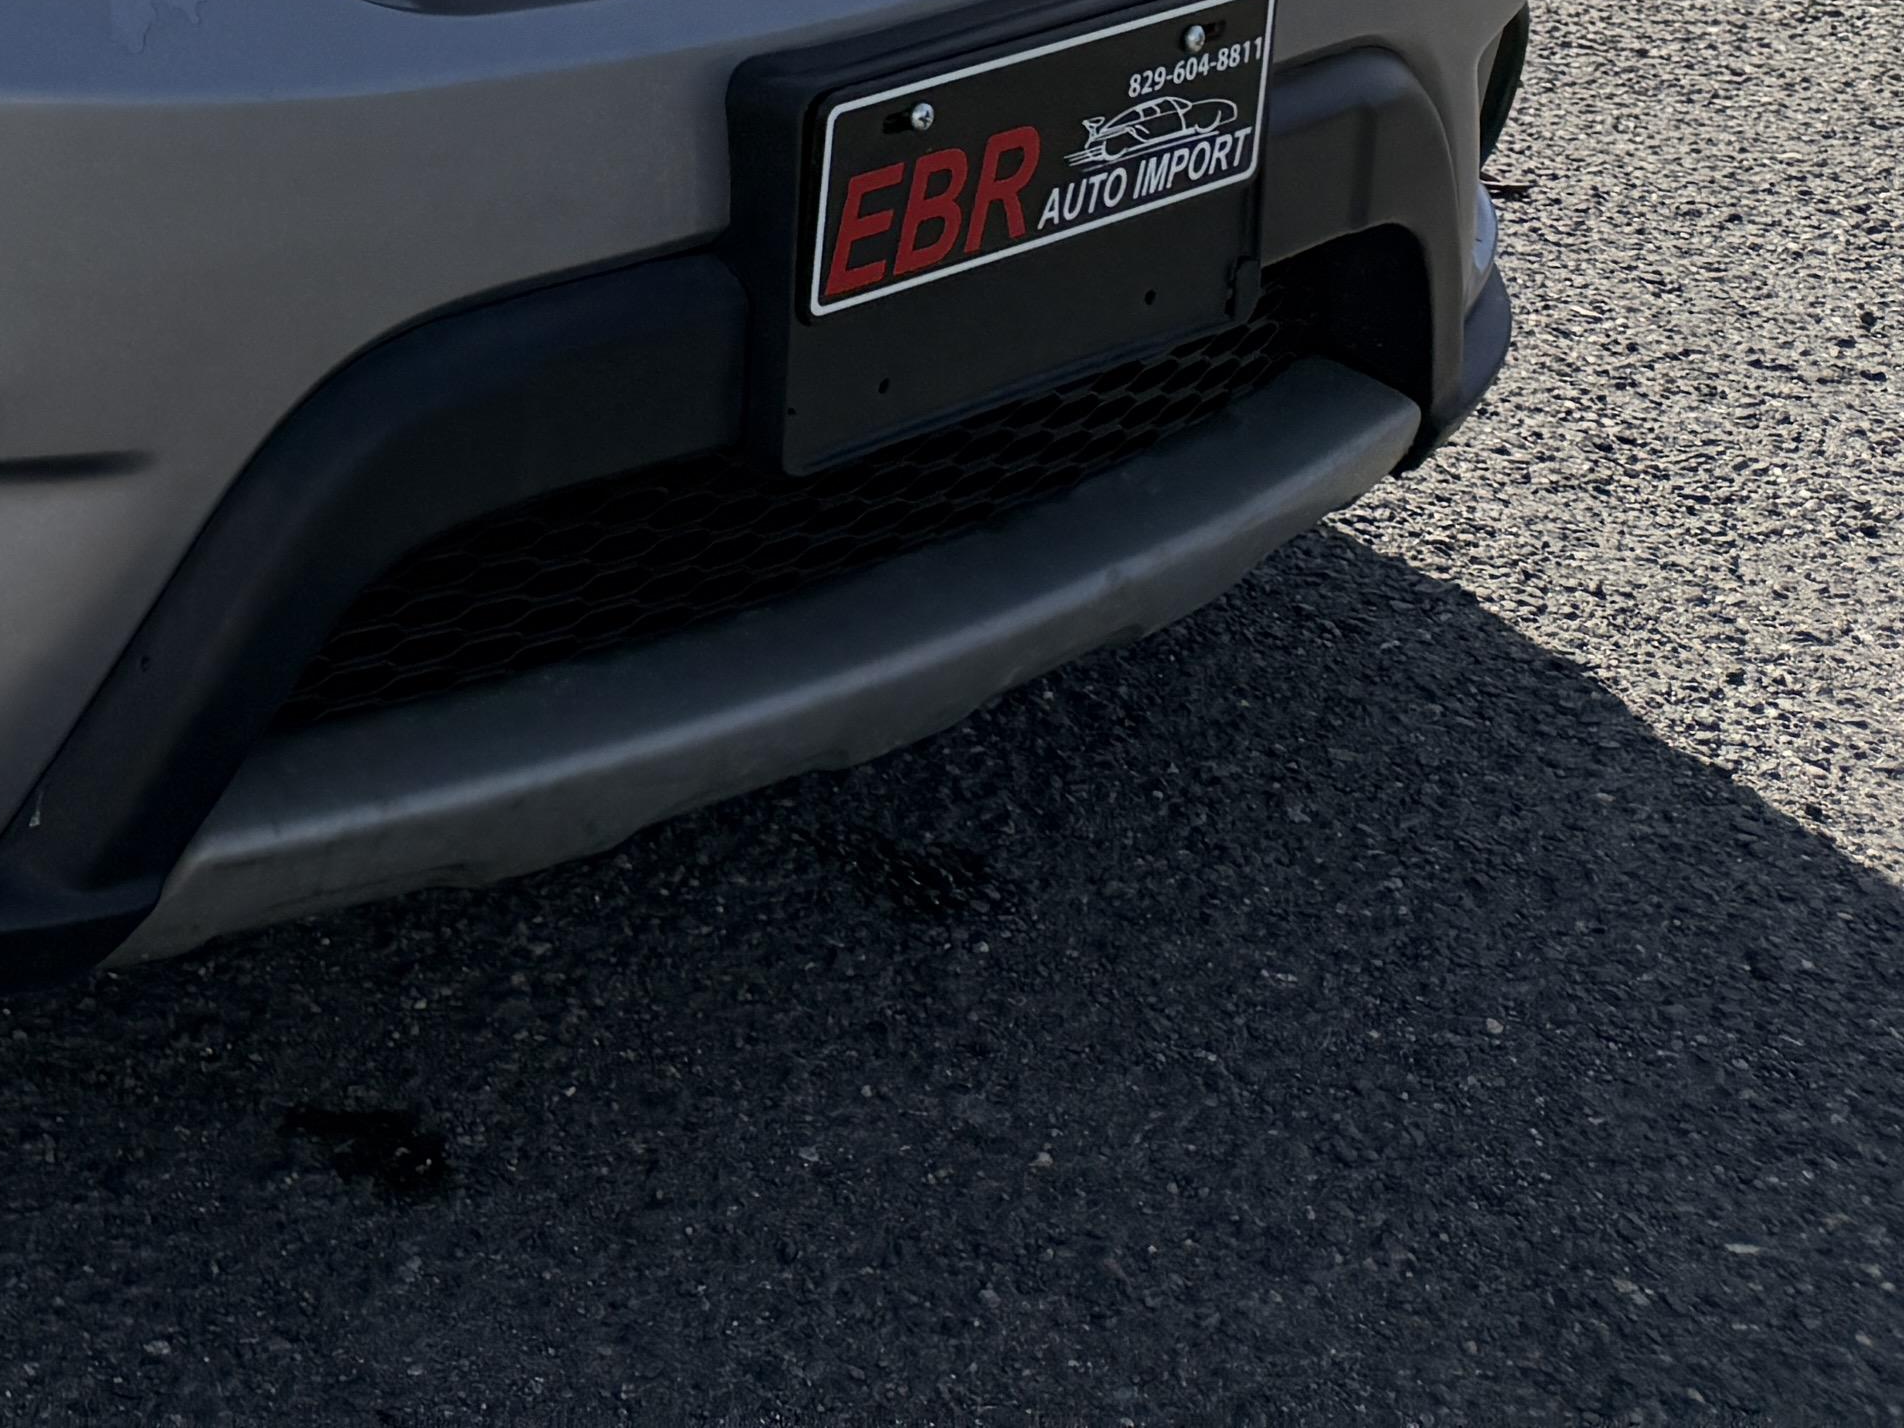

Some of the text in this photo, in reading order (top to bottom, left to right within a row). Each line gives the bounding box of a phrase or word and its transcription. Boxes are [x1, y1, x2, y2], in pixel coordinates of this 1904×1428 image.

[1128, 36, 1263, 98] 829-604-8811
[824, 125, 1041, 297] EBR
[1037, 126, 1253, 230] AUTO IMPORT
